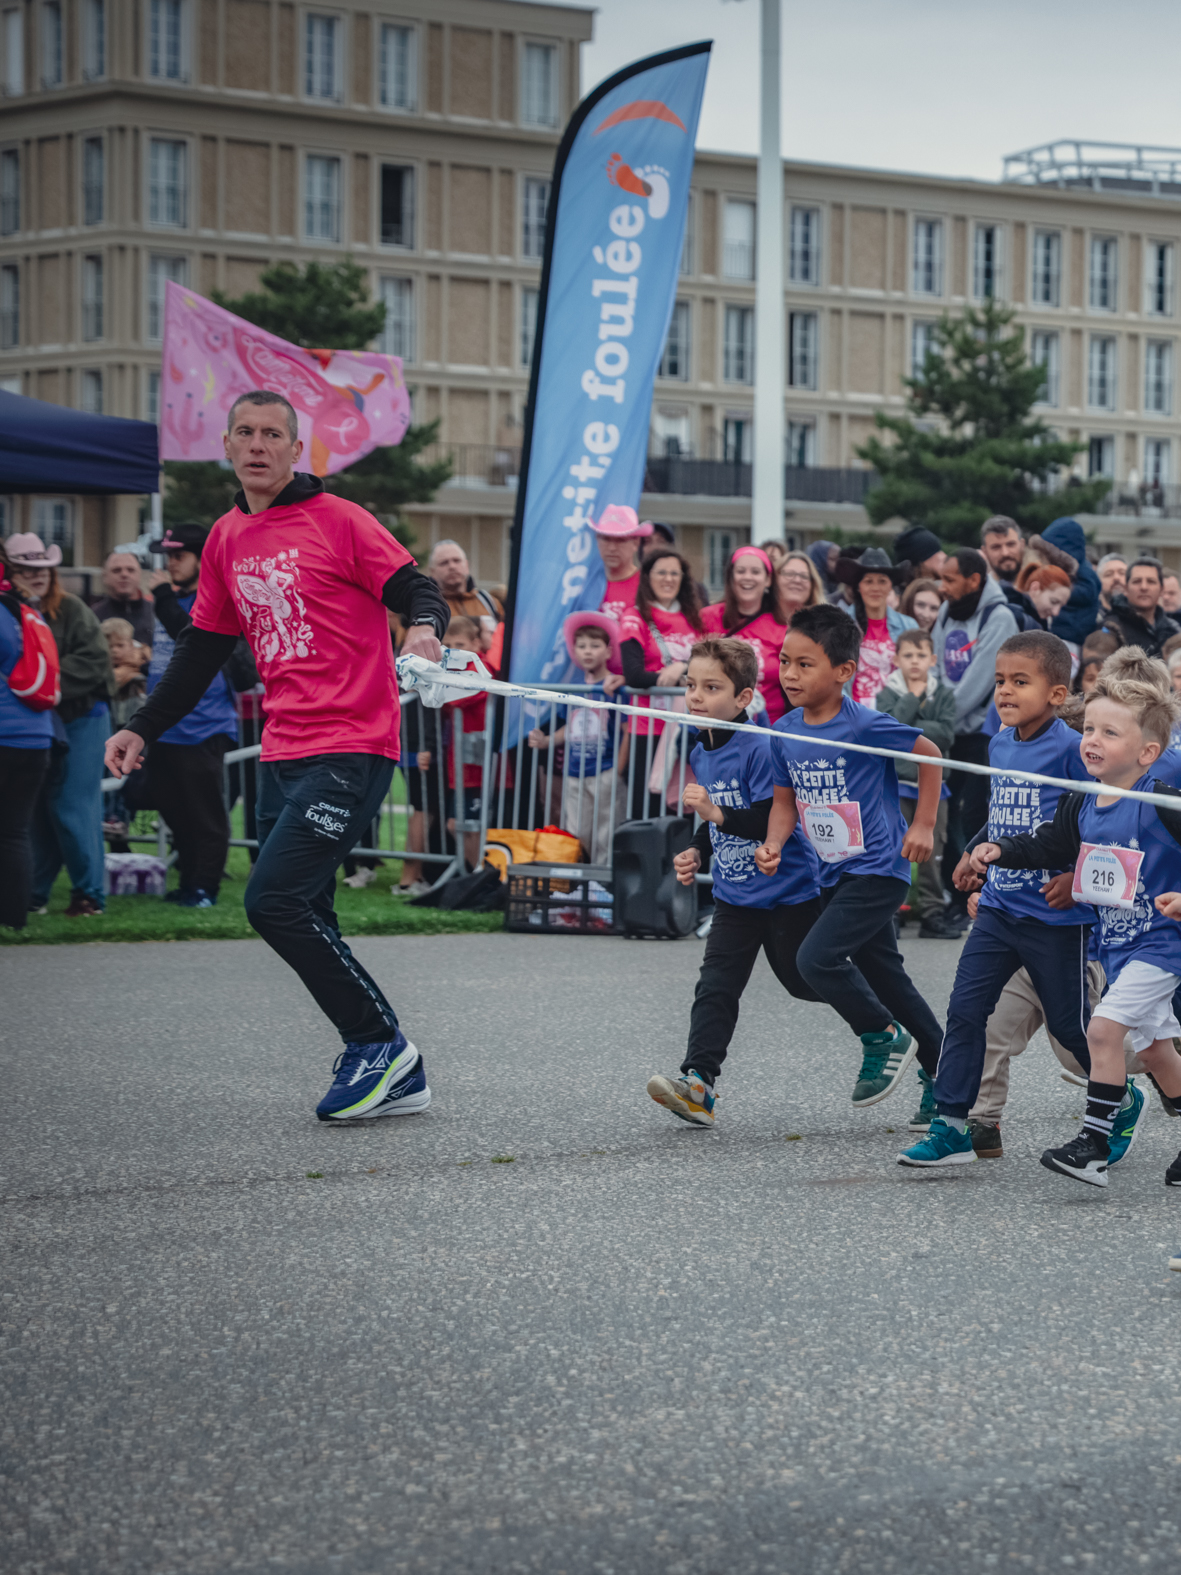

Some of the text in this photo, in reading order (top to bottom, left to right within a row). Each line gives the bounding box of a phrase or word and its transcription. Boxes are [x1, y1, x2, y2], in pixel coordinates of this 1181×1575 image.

[581, 204, 646, 404] foulée
[801, 768, 846, 788] PETITE
[997, 786, 1041, 806] PETITE
[318, 801, 346, 815] CRAFT
[811, 823, 835, 838] 192
[1092, 868, 1115, 887] 216
[1092, 885, 1110, 894] YEEHAW
